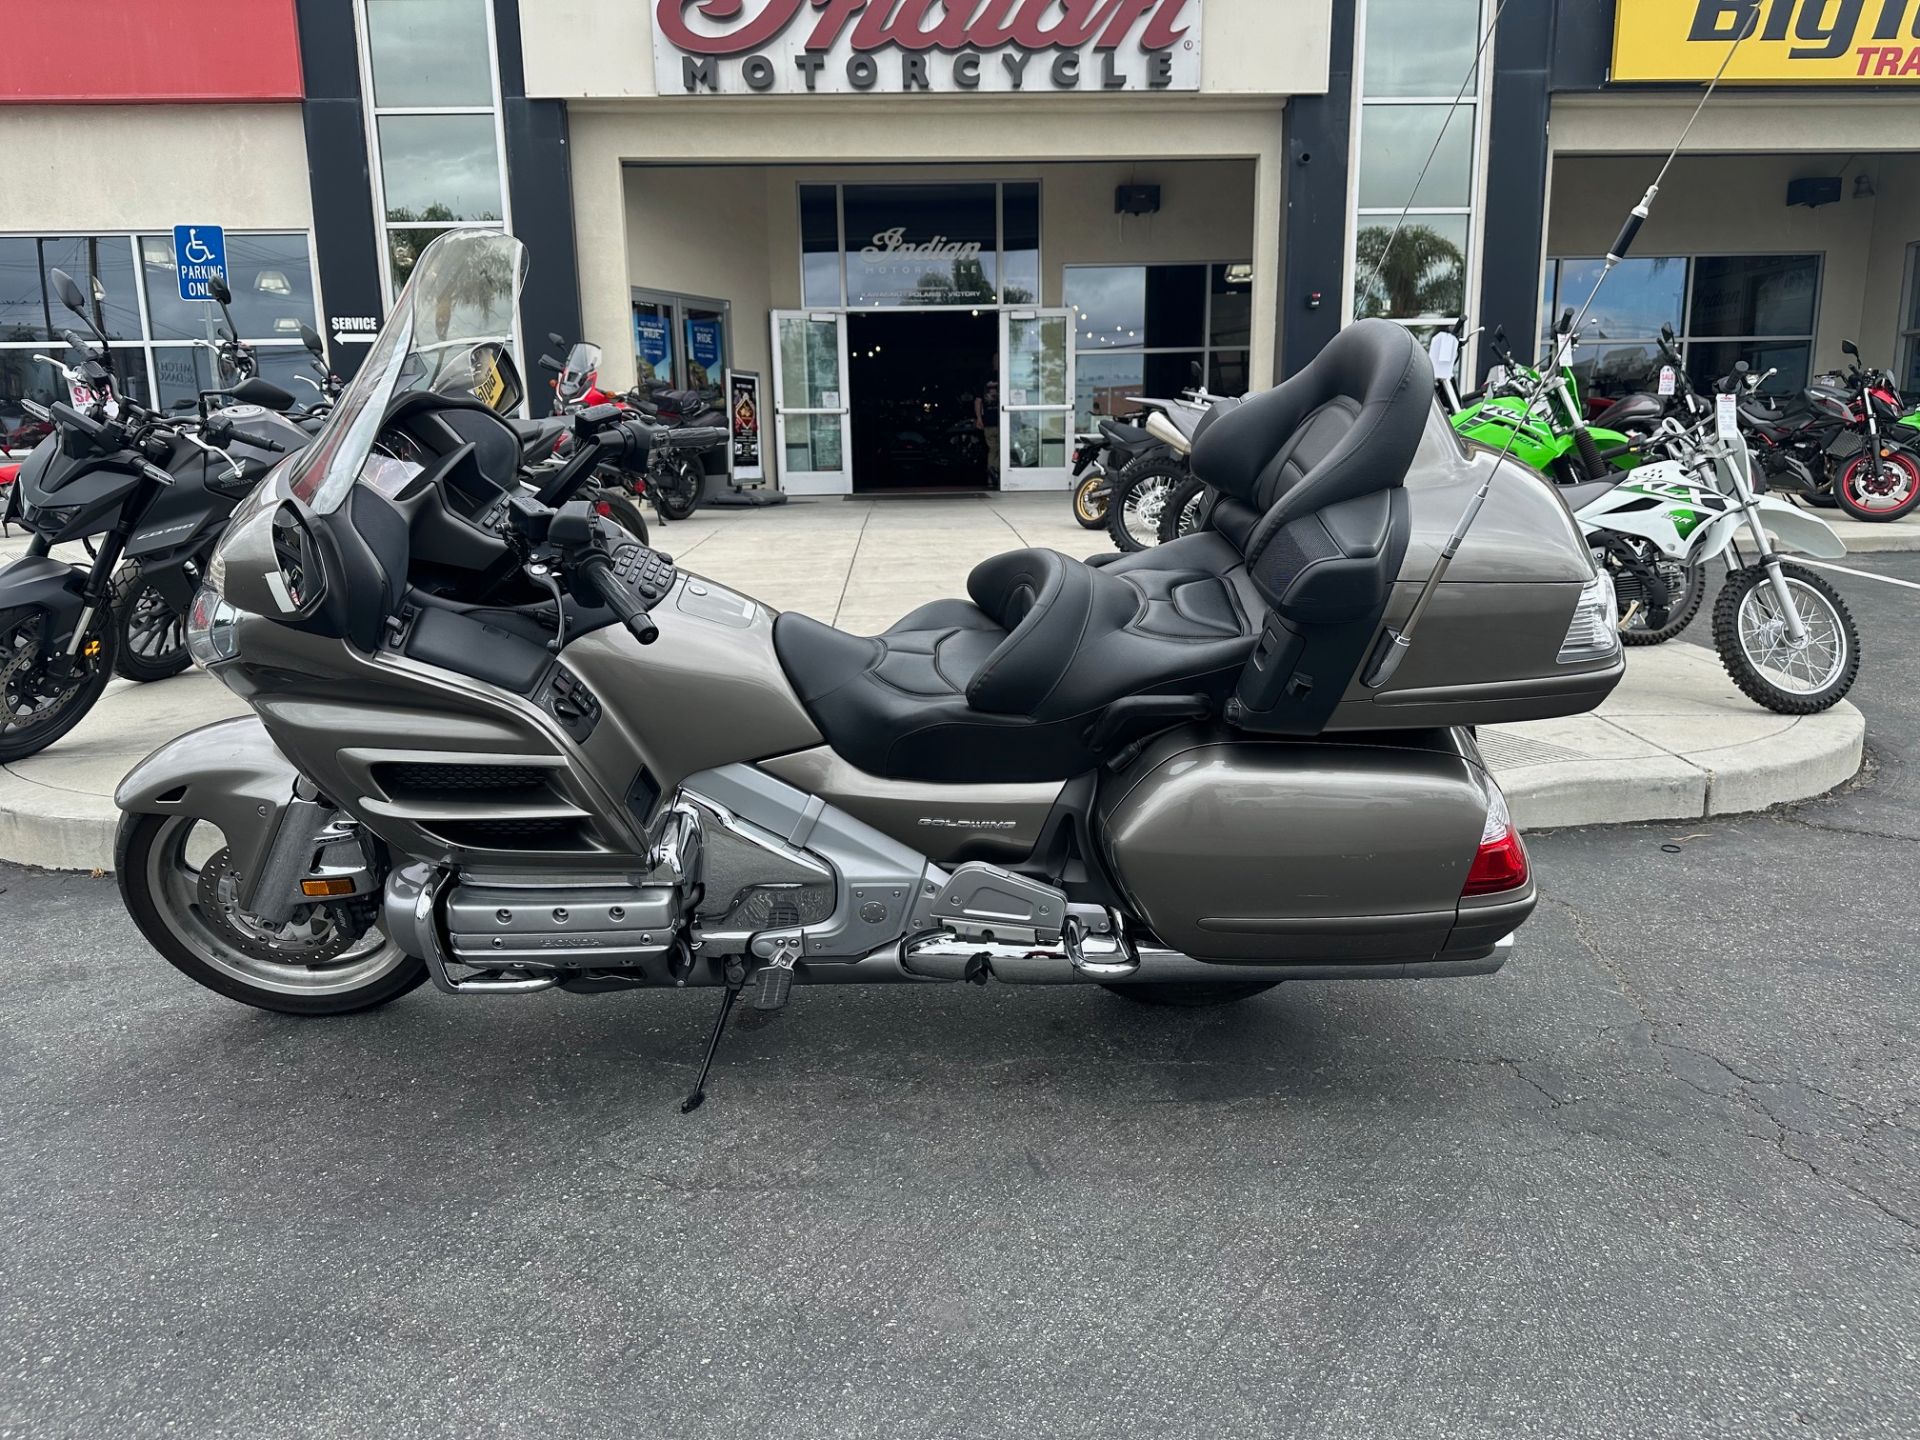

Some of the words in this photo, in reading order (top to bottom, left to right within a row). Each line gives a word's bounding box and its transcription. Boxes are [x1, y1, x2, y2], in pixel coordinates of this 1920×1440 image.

[1686, 0, 1920, 59] Big
[682, 52, 1172, 91] MOTORCYCLE
[860, 227, 982, 264] Indian
[181, 265, 224, 279] PARKING
[188, 282, 213, 296] ONL
[331, 317, 377, 330] SERVICE
[643, 330, 661, 339] RIDE
[696, 333, 713, 344] RIDE
[220, 479, 254, 489] HONDA
